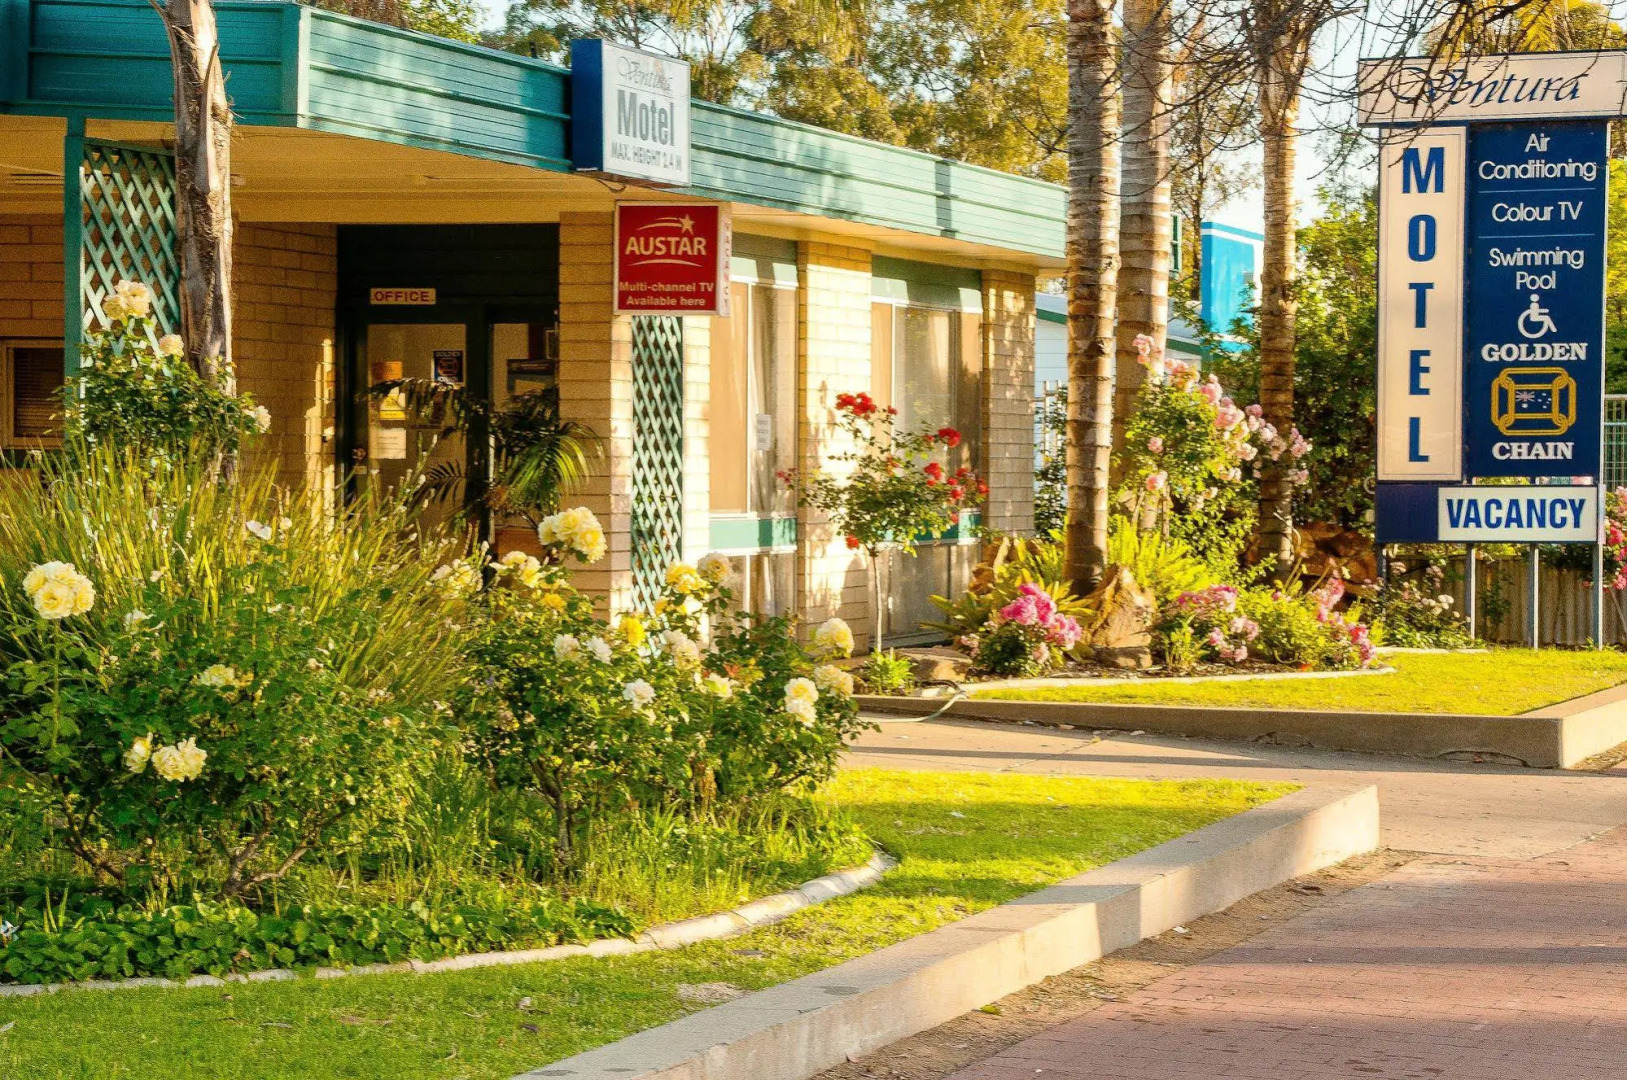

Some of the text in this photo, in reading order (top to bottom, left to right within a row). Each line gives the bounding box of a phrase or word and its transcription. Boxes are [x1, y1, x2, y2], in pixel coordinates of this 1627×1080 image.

[1389, 66, 1589, 106] Ventura
[617, 89, 675, 147] Motel
[1524, 133, 1551, 153] Air
[632, 145, 661, 167] HEIGHT
[1478, 158, 1598, 182] Conditioning
[1491, 201, 1583, 222] Colour TV
[625, 236, 707, 256] AUSTAR
[1488, 247, 1585, 269] Swimming
[619, 282, 715, 293] Multi-channel TV
[1515, 271, 1557, 290] Pool
[374, 290, 430, 302] OFFICE
[626, 295, 706, 306] Available here
[1401, 146, 1446, 463] MOTEL
[1481, 343, 1588, 362] GOLDEN
[1491, 442, 1574, 460] CHAIN
[1446, 498, 1586, 529] VACANCY
